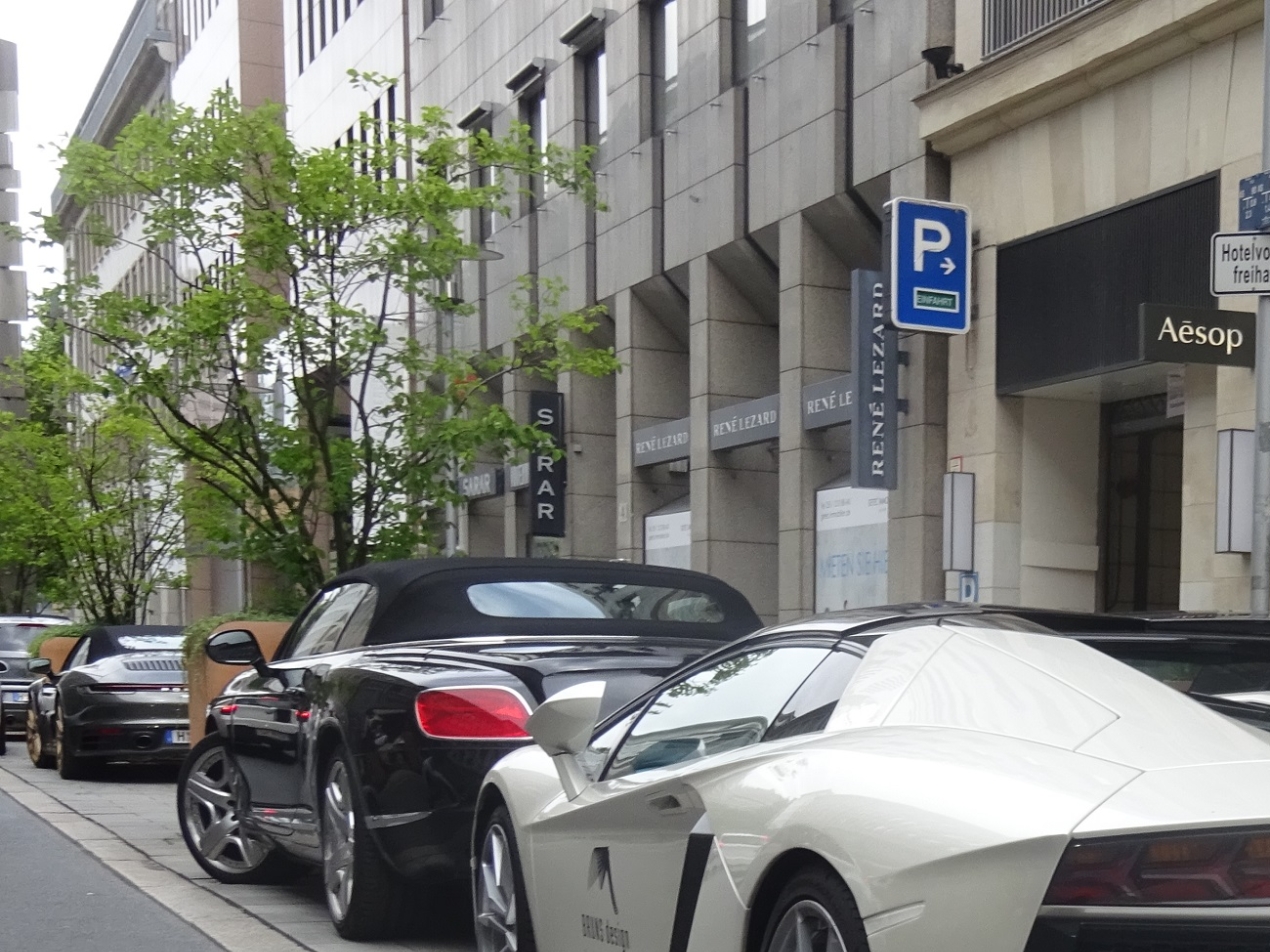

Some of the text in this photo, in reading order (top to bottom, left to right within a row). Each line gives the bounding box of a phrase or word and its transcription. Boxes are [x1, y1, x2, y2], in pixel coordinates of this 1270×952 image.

[914, 218, 951, 272] P
[917, 294, 953, 307] EINFAHRT
[1157, 316, 1243, 355] Aēsop
[869, 282, 885, 477] RENÉ LEZARD
[807, 390, 837, 415] RENÉ
[713, 410, 777, 437] RENÉ LEZARD
[657, 431, 688, 450] LEZARD
[536, 408, 556, 520] SRAR
